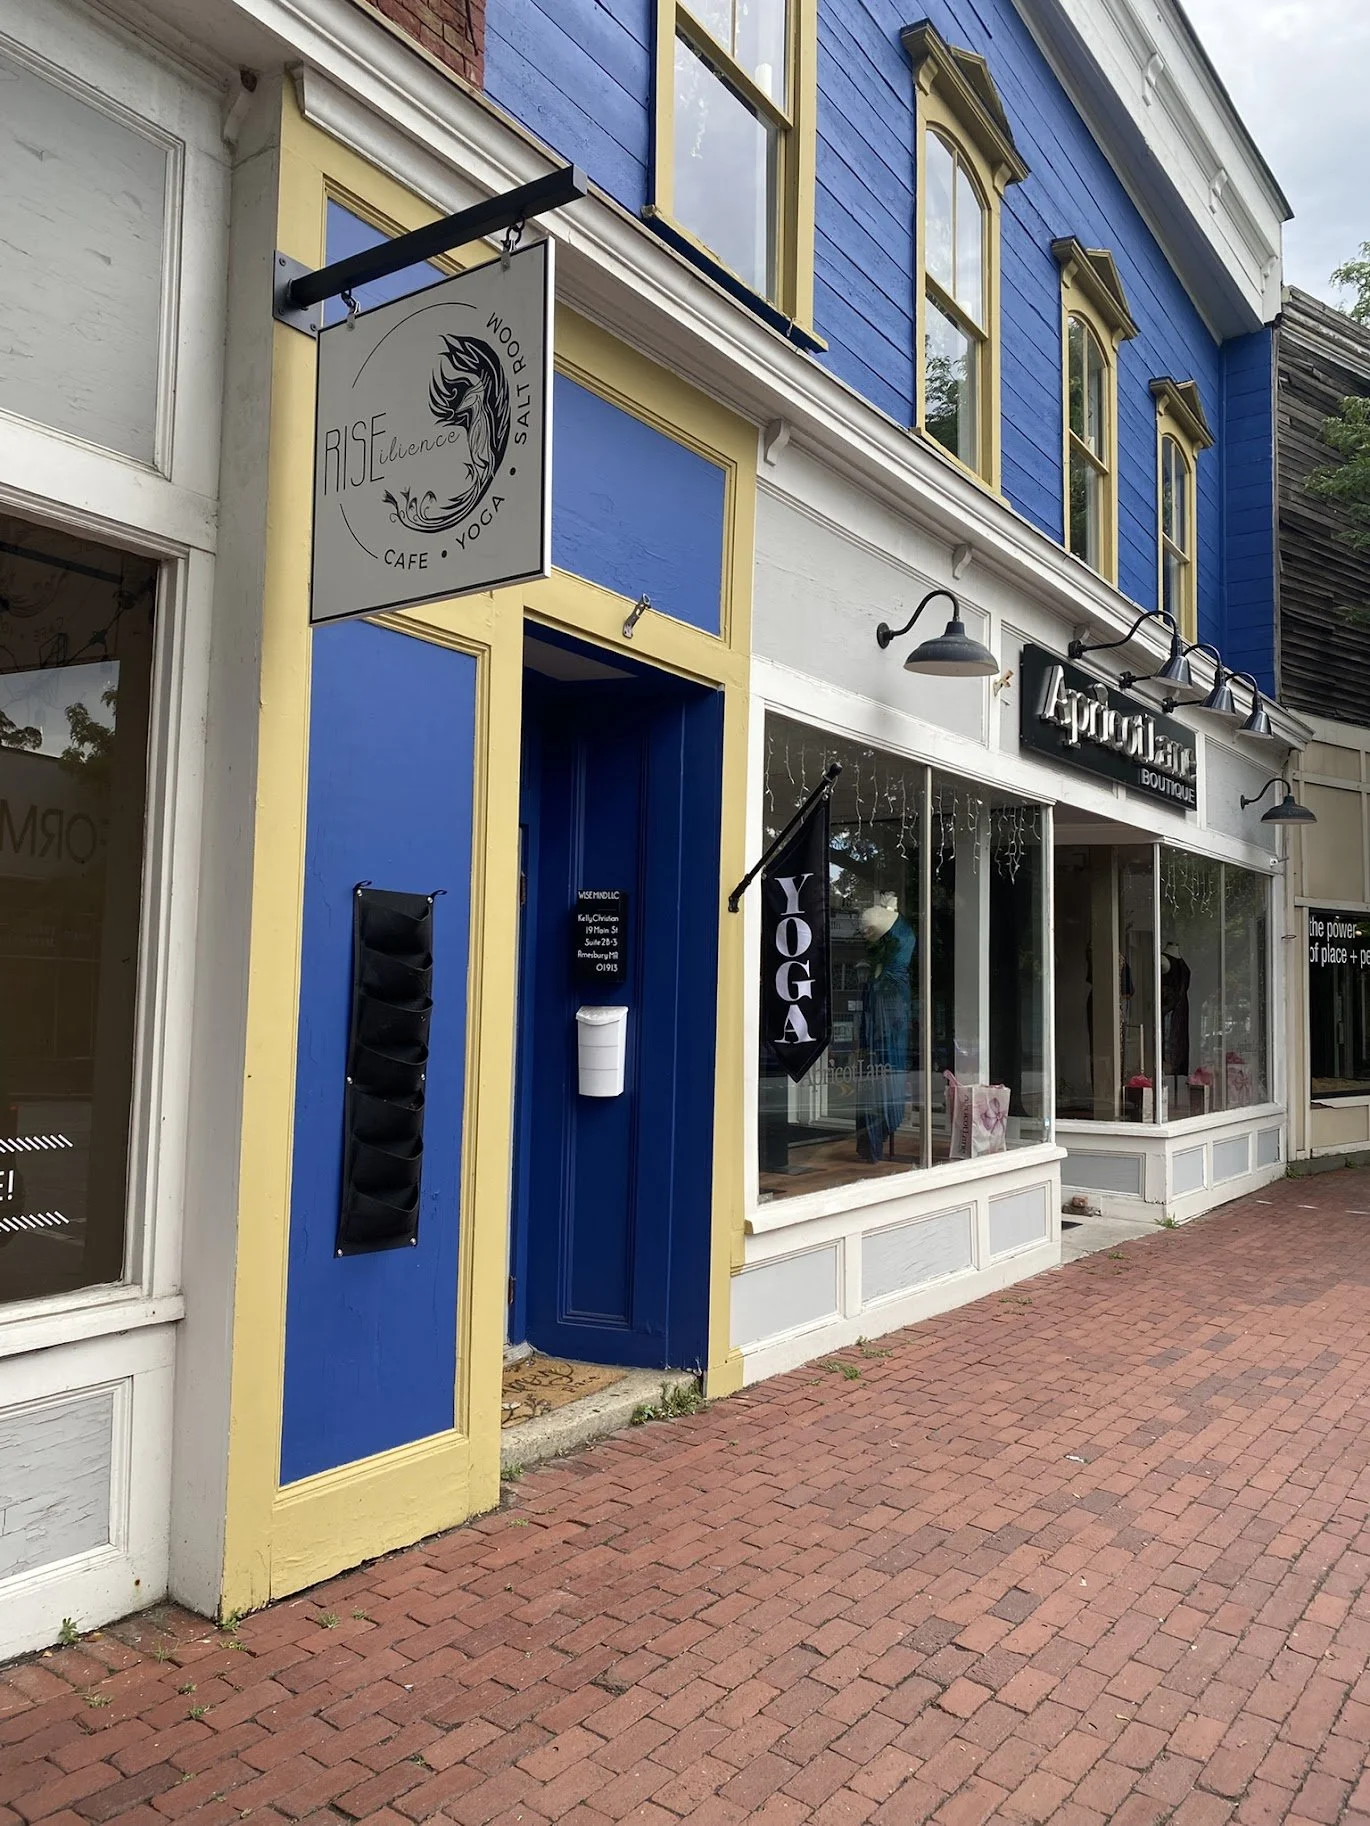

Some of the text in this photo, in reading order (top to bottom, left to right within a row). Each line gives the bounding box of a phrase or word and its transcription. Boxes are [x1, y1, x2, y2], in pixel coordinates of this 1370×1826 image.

[384, 311, 530, 569] CAFE YOGA SALT ROOM
[1139, 769, 1196, 804] BOUTIQUE
[593, 926, 610, 934] Main
[611, 925, 618, 934] St
[1327, 921, 1357, 941] power
[774, 872, 816, 1044] YOGA
[1321, 943, 1347, 967] place
[596, 963, 618, 972] 01913
